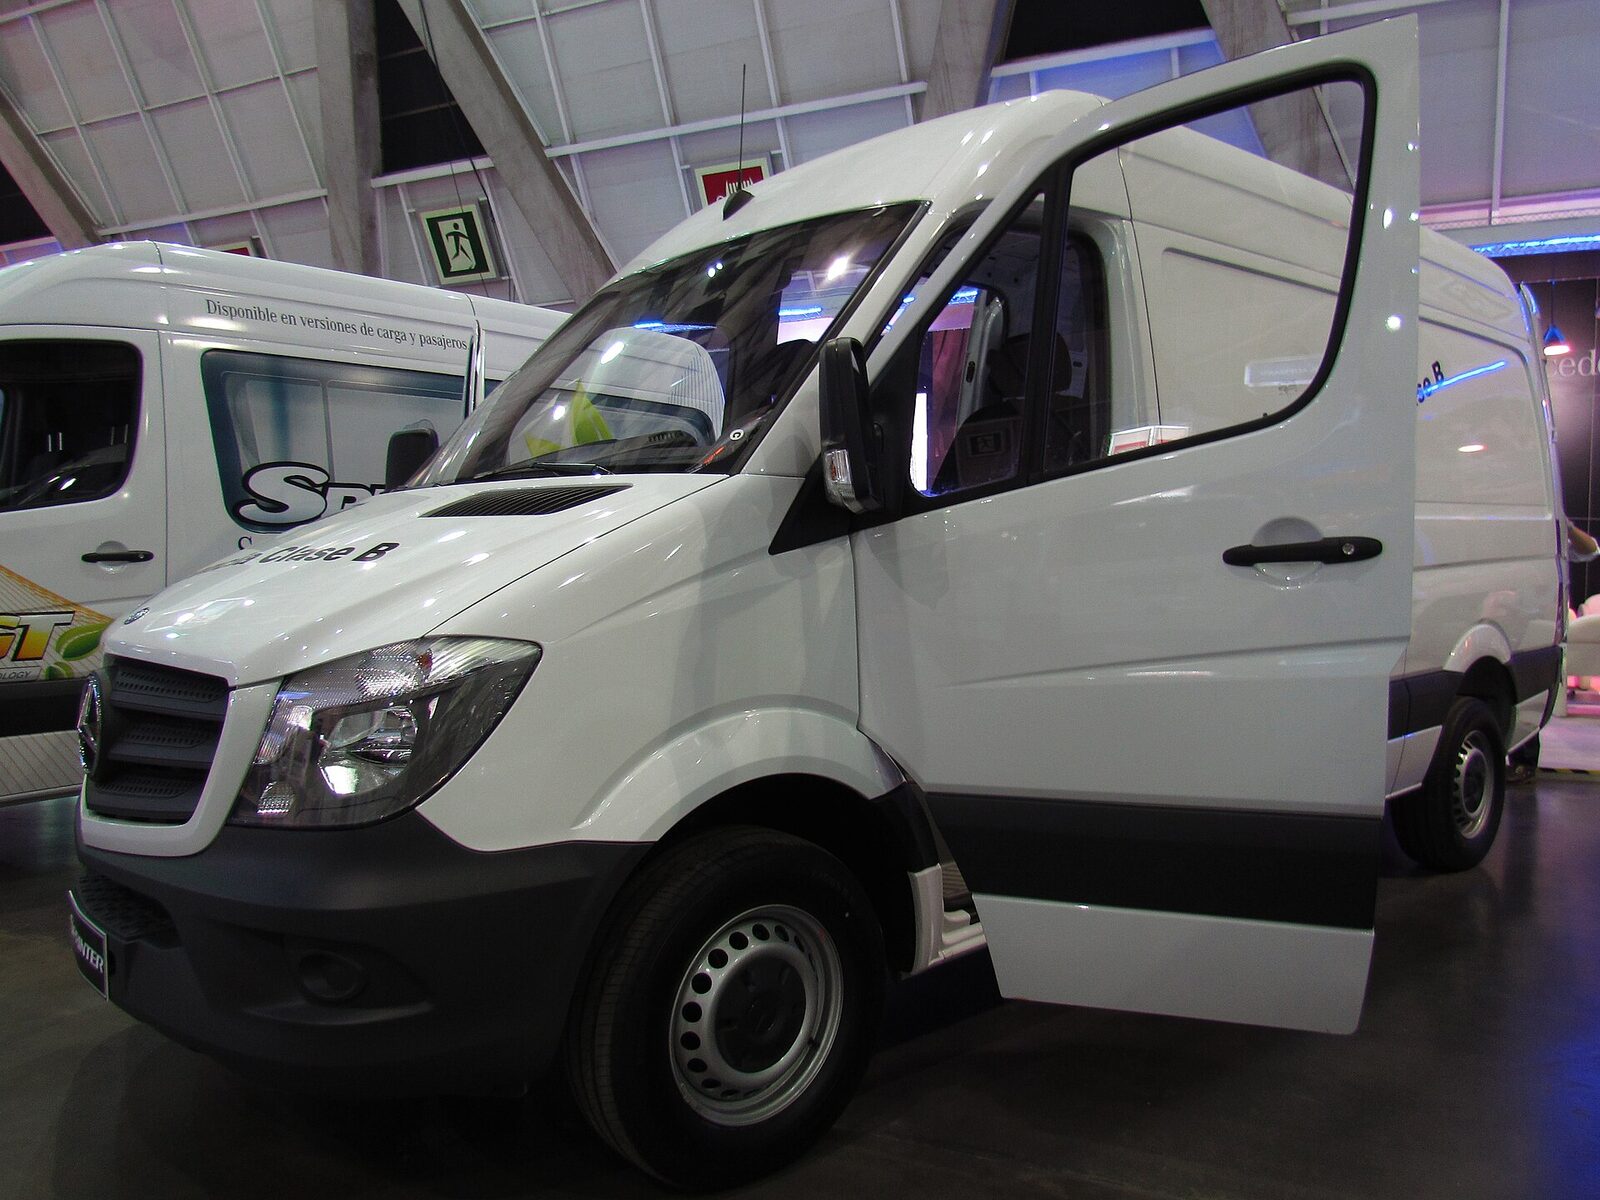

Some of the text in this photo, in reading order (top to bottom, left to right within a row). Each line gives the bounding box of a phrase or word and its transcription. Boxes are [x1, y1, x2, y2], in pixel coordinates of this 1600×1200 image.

[206, 299, 469, 350] Disponible en versiones de carga y pasajeros
[258, 545, 356, 564] Clase
[351, 542, 400, 562] B
